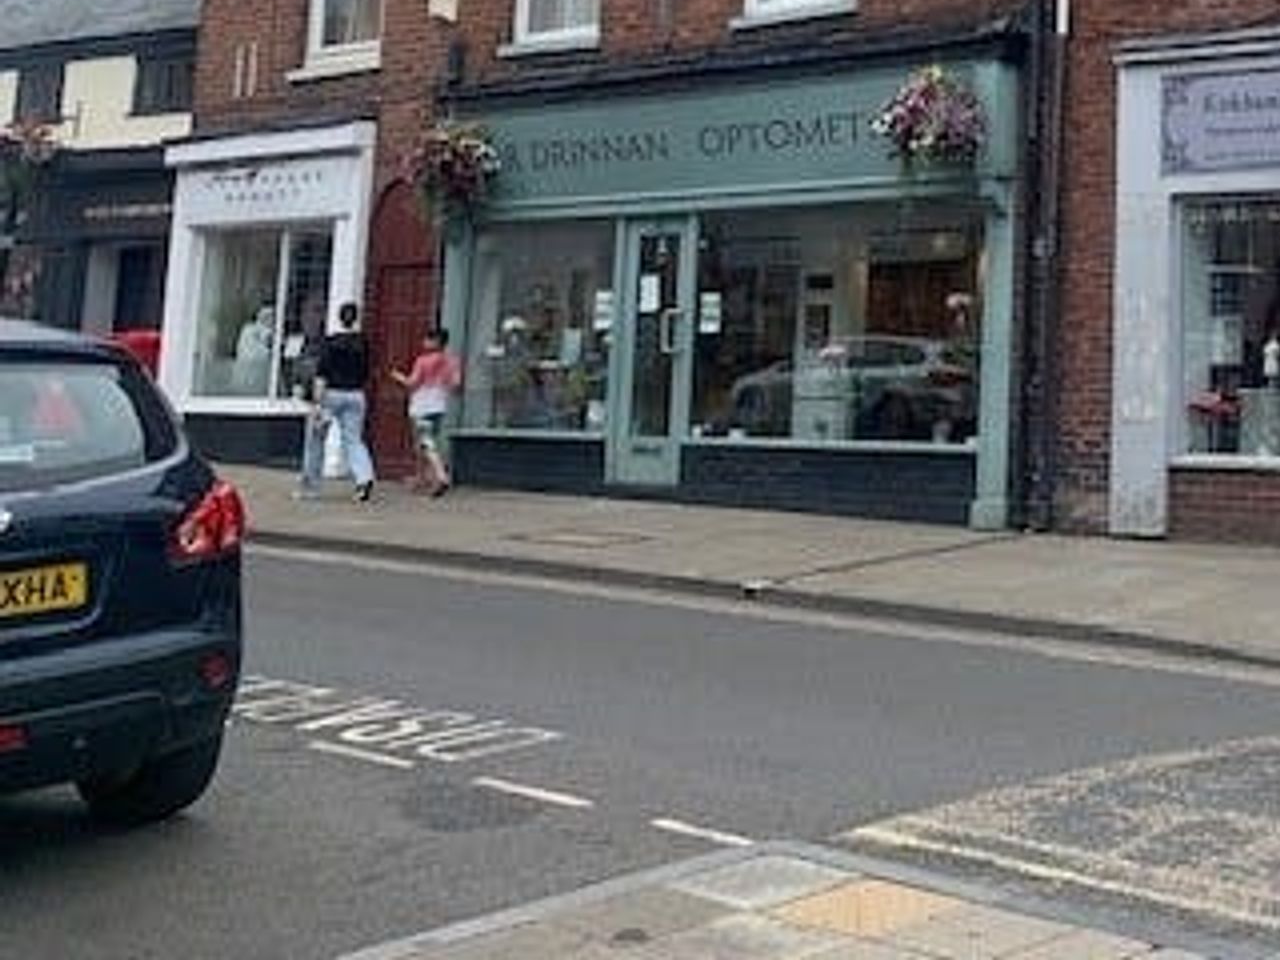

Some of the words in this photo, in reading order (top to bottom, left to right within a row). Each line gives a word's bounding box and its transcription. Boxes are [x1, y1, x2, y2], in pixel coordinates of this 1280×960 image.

[531, 131, 670, 170] DRINNAN
[700, 111, 861, 157] OPTOMET
[3, 571, 70, 607] XHA
